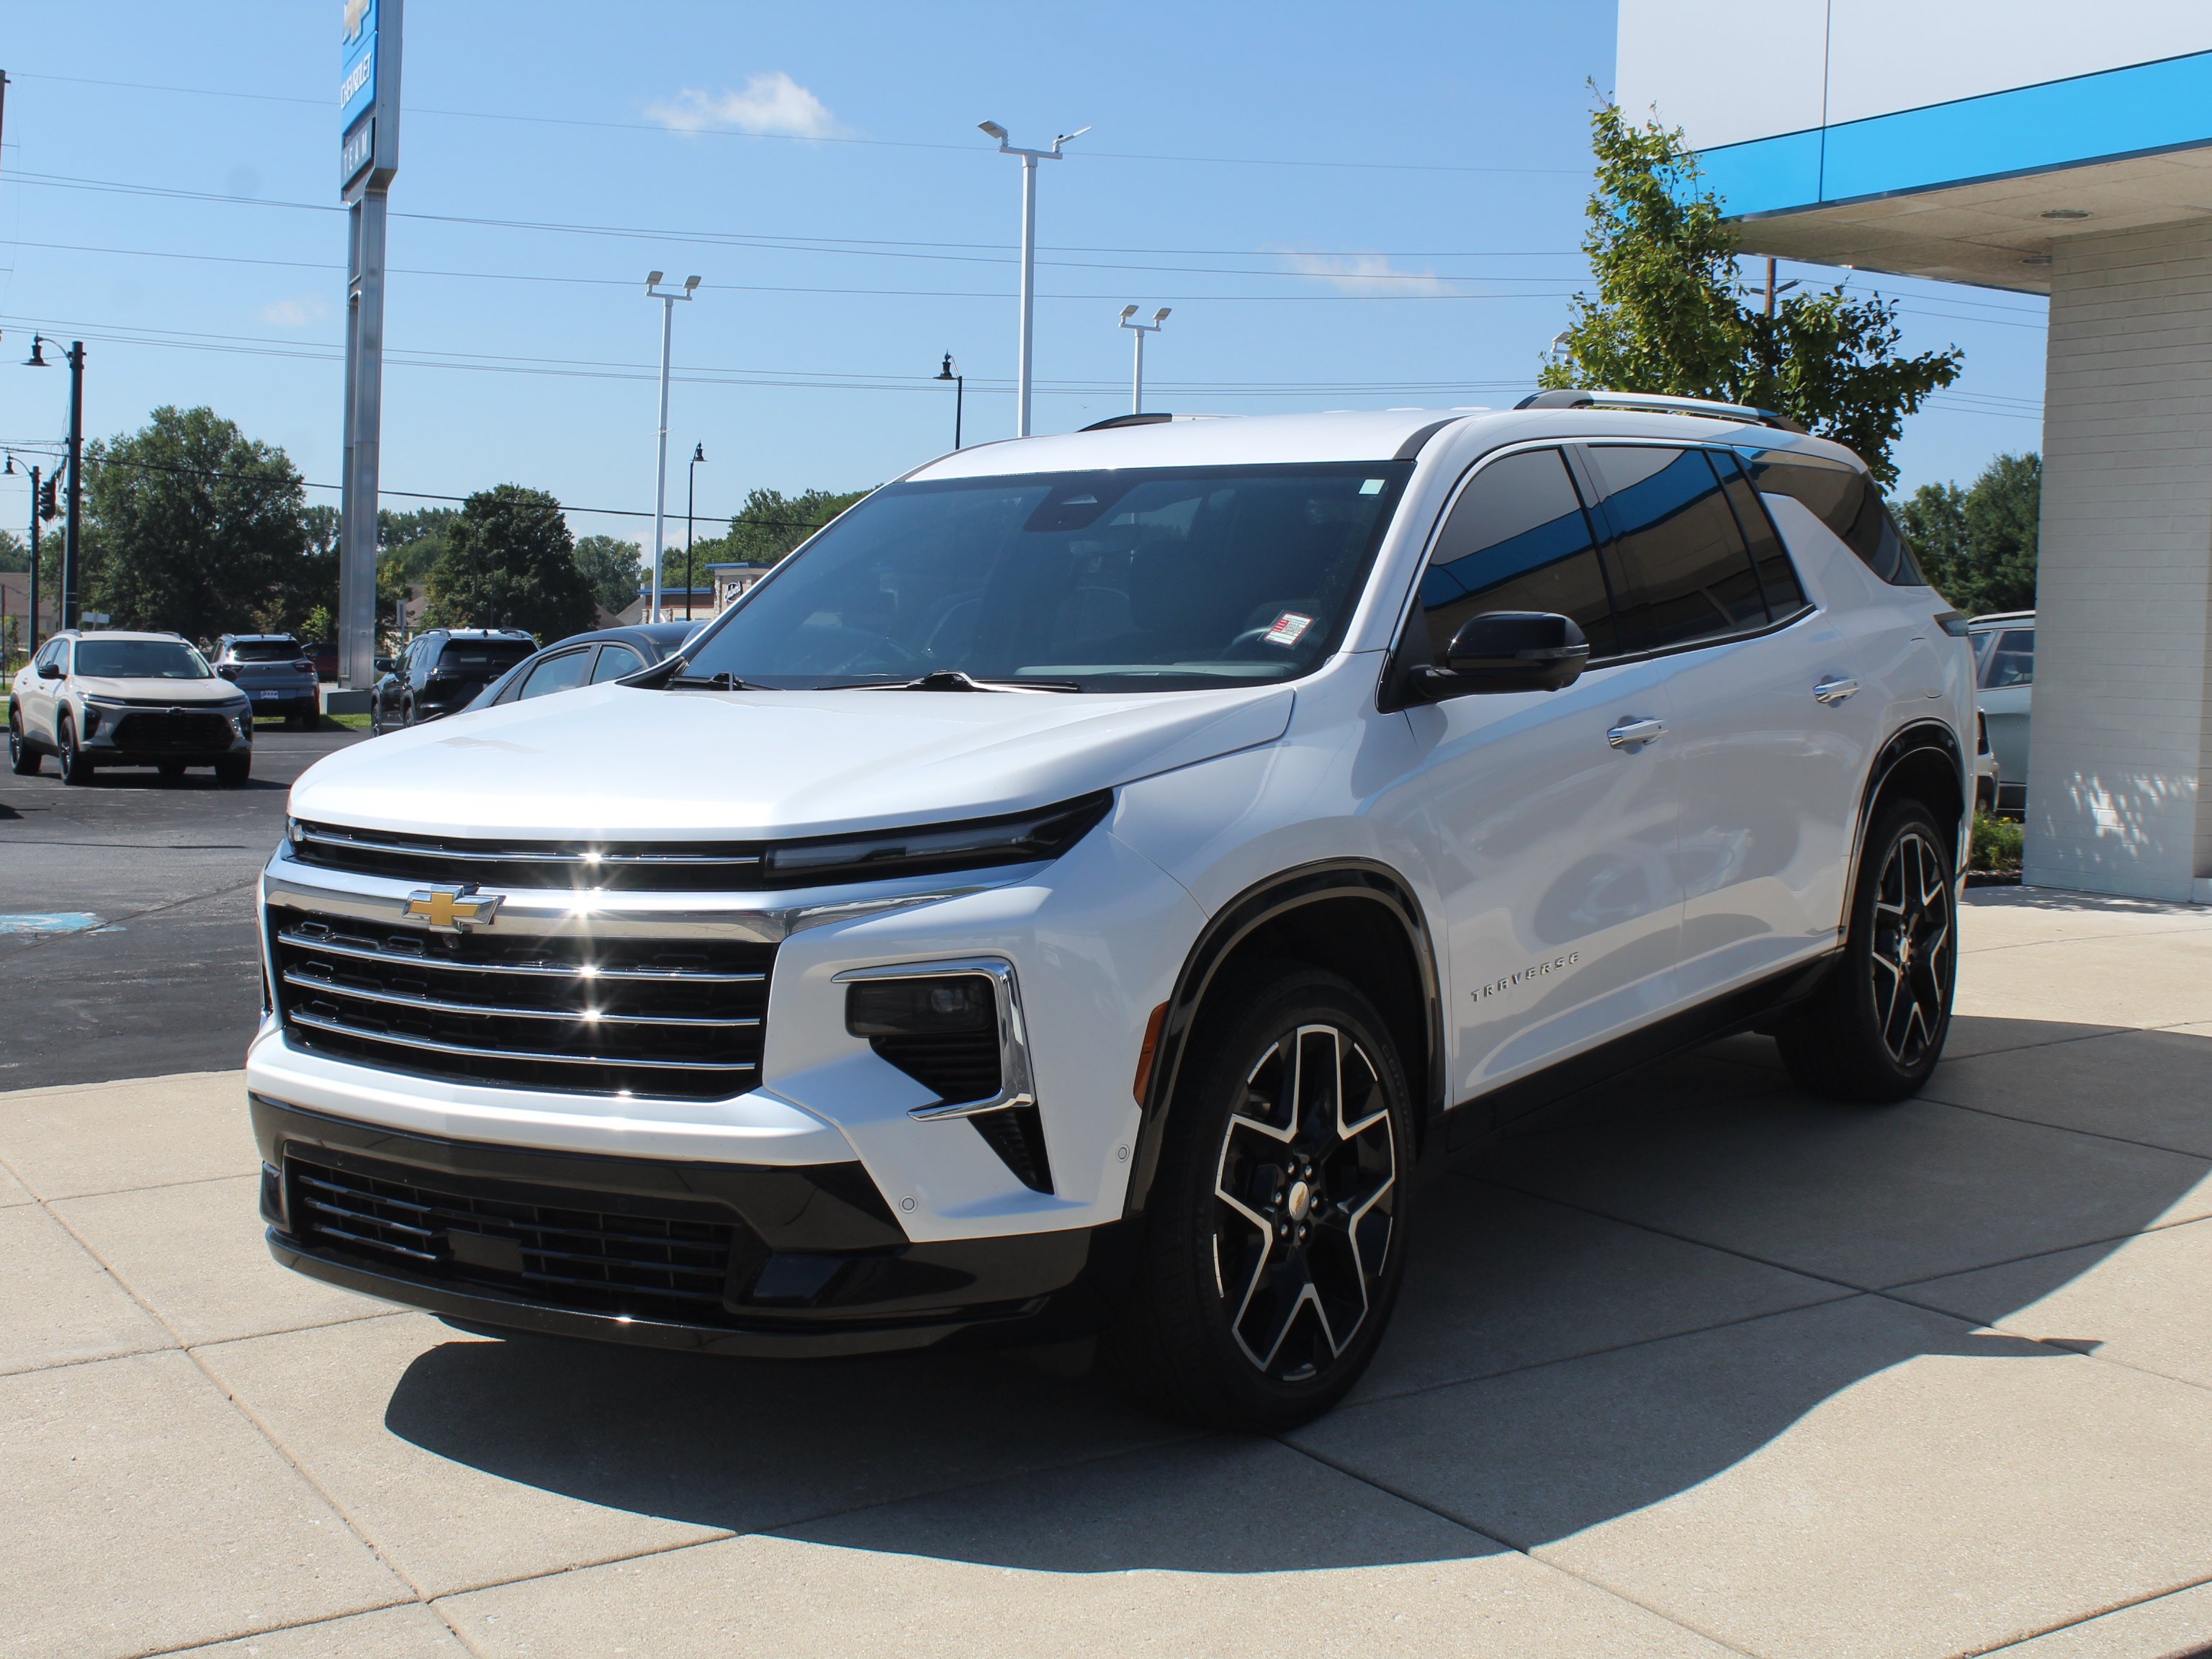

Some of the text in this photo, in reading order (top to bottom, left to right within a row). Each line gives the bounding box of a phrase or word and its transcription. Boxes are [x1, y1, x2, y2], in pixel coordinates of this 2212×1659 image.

[341, 51, 372, 109] CHEVROLET
[343, 130, 367, 177] TEAM
[1471, 952, 1579, 1002] TRAVERSE
